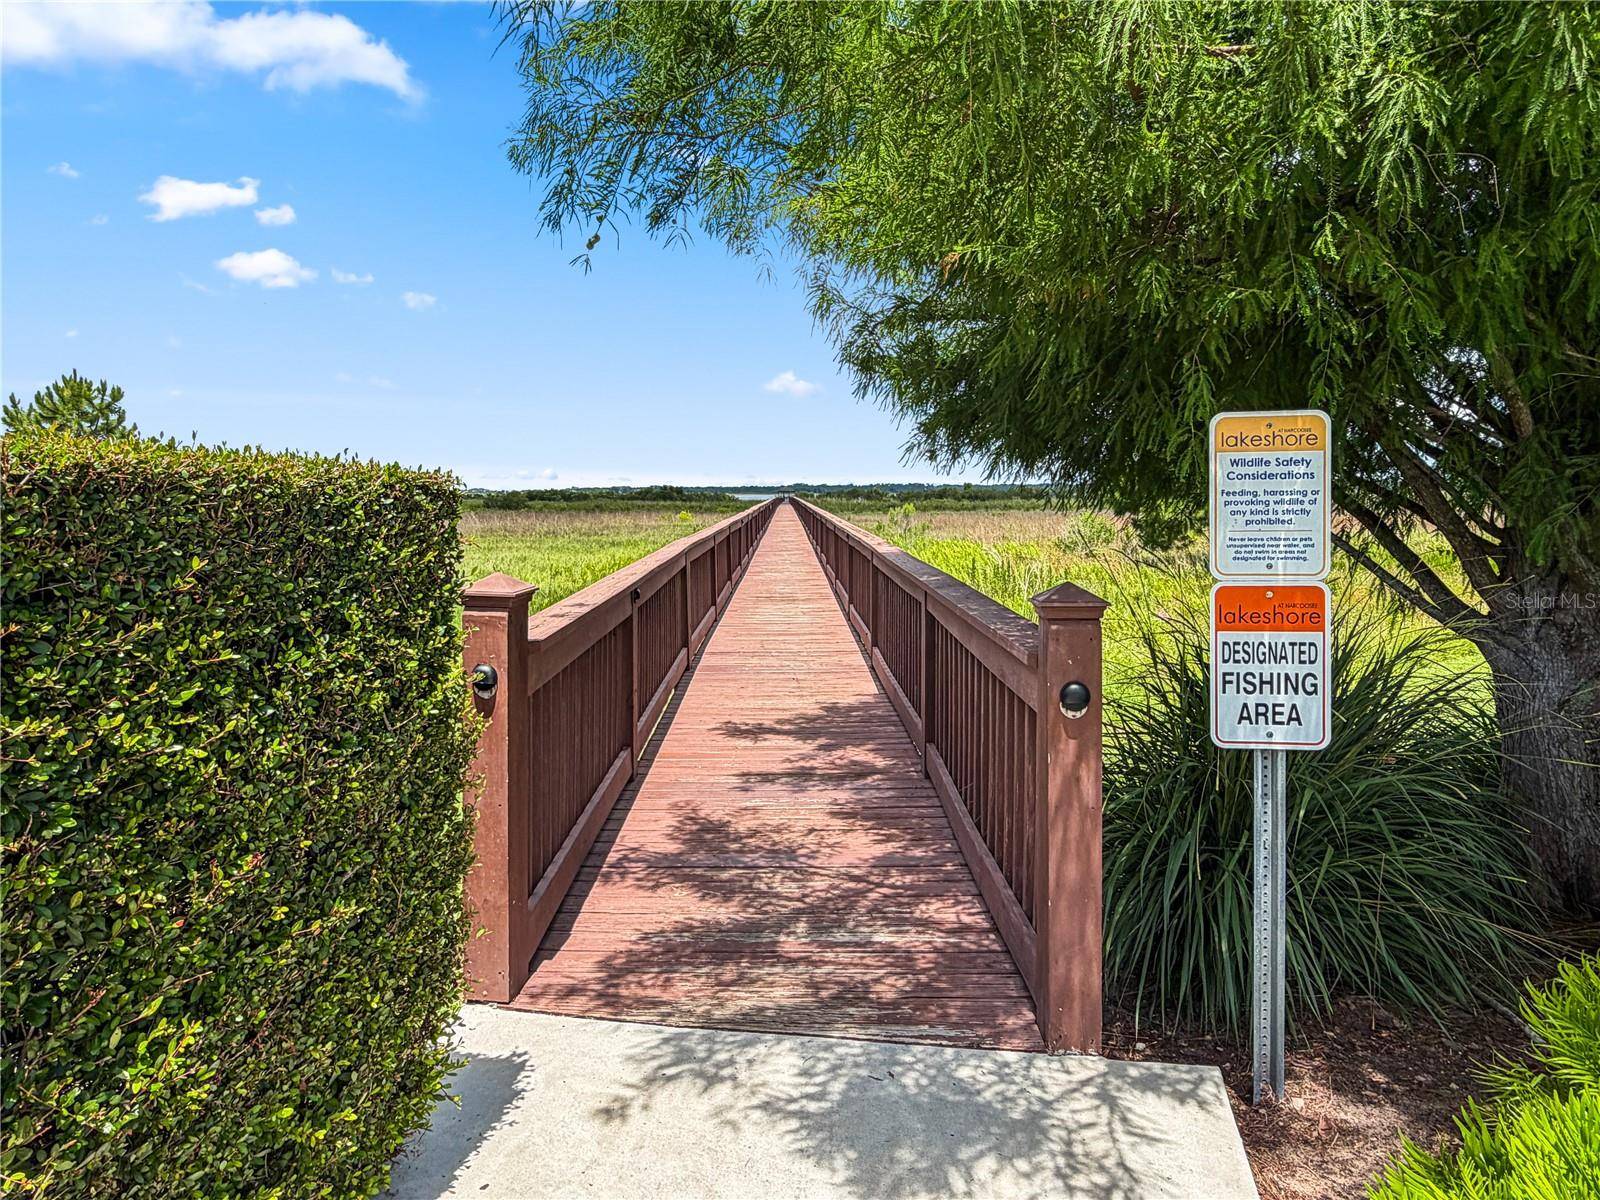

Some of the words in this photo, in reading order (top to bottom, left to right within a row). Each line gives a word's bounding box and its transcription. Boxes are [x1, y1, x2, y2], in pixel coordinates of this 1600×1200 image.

[1221, 431, 1319, 447] lakeshore
[1230, 457, 1272, 467] Wildlife
[1275, 456, 1312, 468] Safety
[1227, 470, 1315, 480] Considerations
[1221, 489, 1261, 498] Feeding,
[1264, 488, 1308, 498] harassing
[1224, 499, 1270, 507] provoking
[1273, 498, 1305, 506] wildlife
[1308, 497, 1317, 505] of
[1230, 509, 1247, 517] any
[1250, 508, 1270, 516] kind
[1282, 507, 1312, 517] strictly
[1245, 517, 1296, 526] prohibited.
[1219, 604, 1321, 624] lakeshore
[1222, 641, 1318, 664] DESIGNATED
[1222, 672, 1318, 696] FISHING
[1237, 702, 1303, 726] AREA
